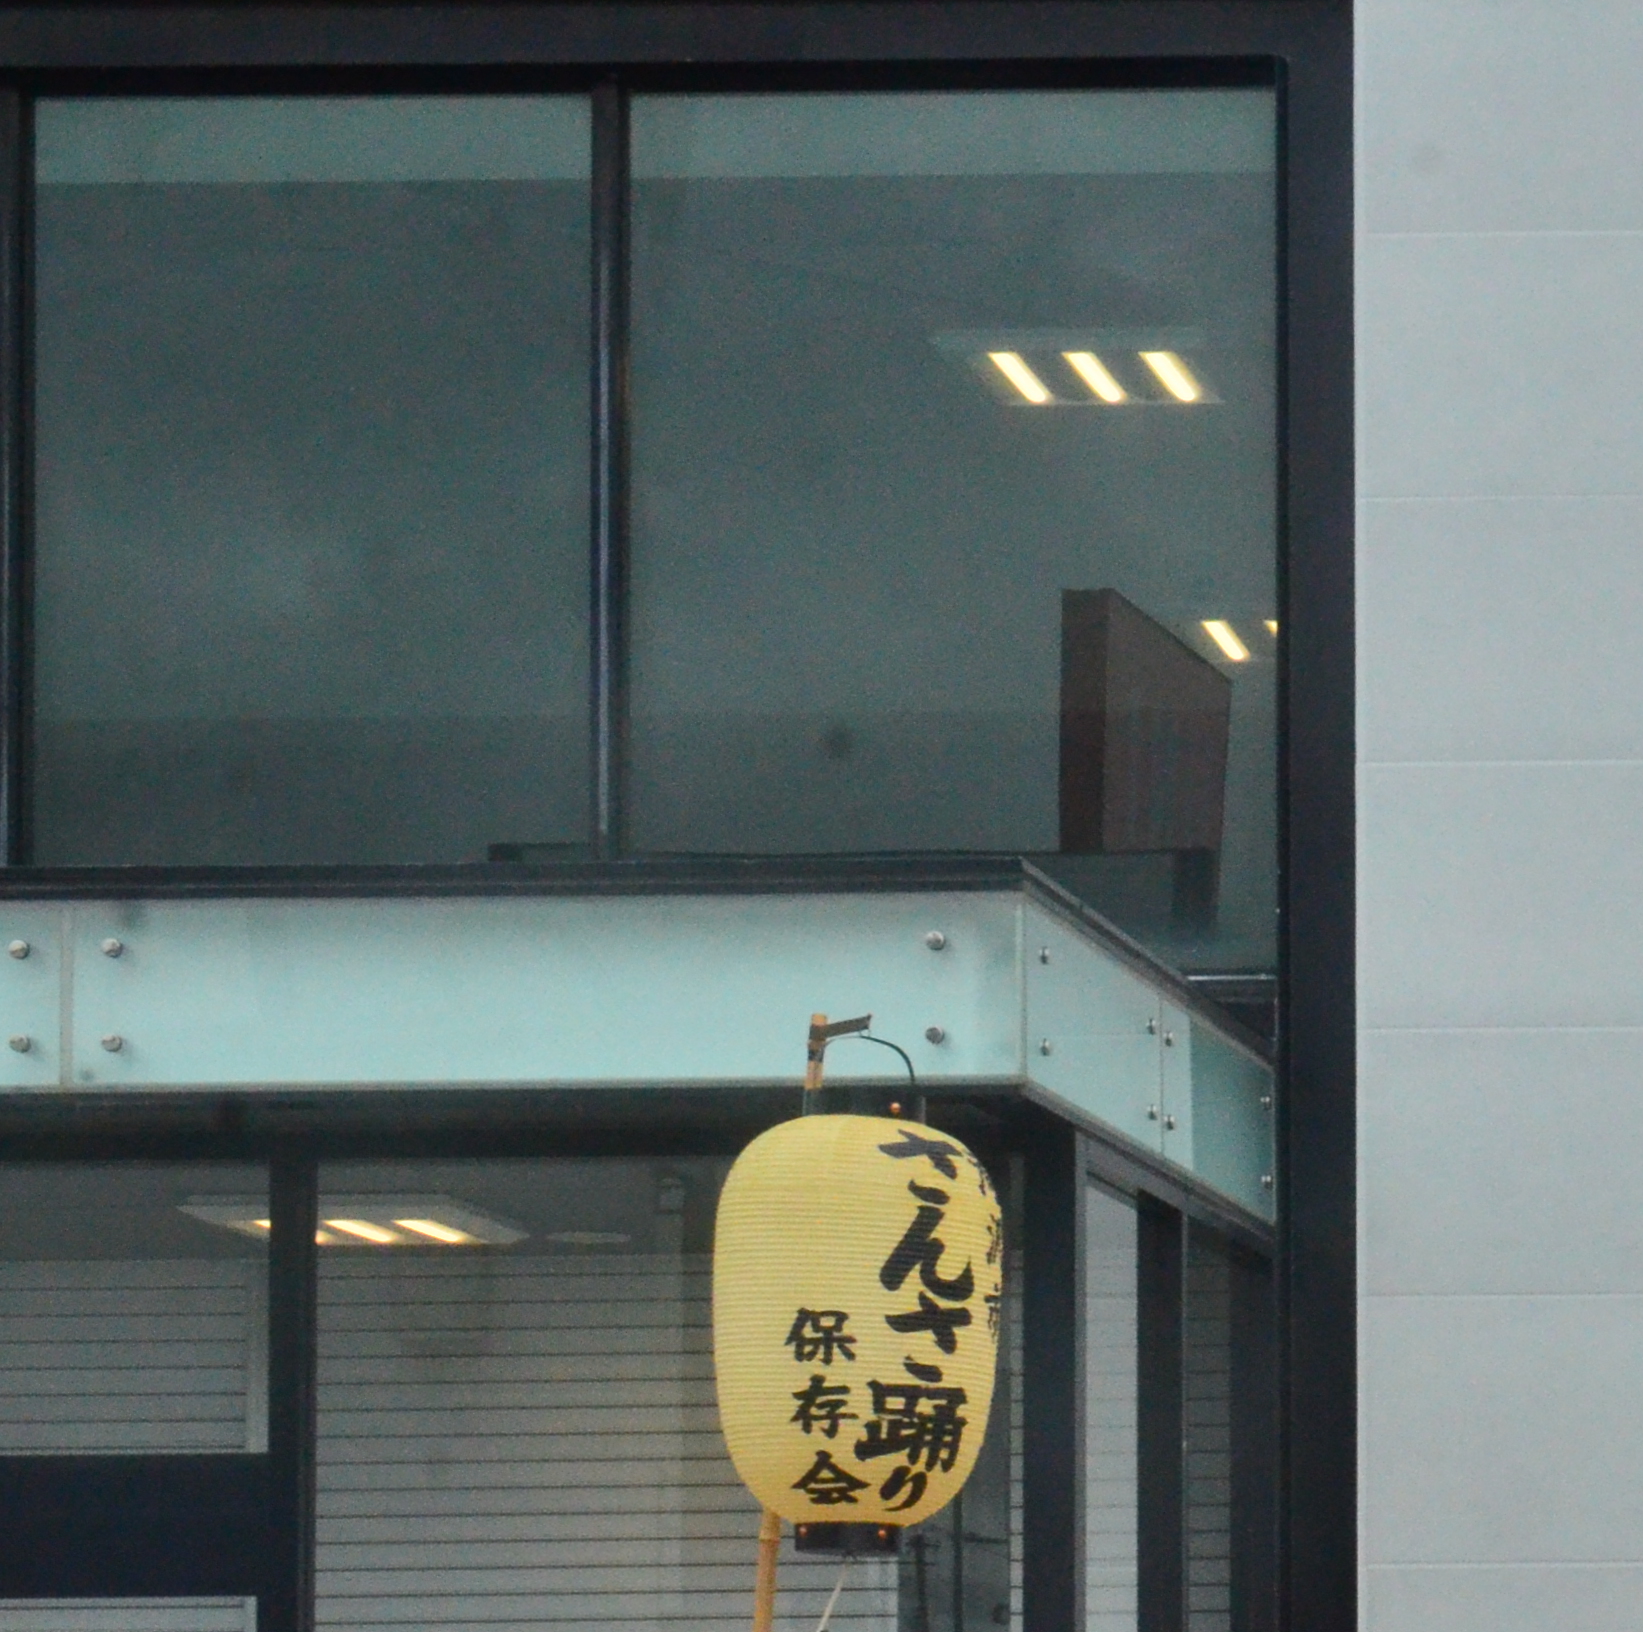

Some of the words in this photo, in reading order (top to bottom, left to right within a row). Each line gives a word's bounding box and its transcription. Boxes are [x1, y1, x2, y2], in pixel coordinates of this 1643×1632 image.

[785, 1308, 870, 1505] 保存会
[854, 1129, 974, 1511] さんさ踊り
